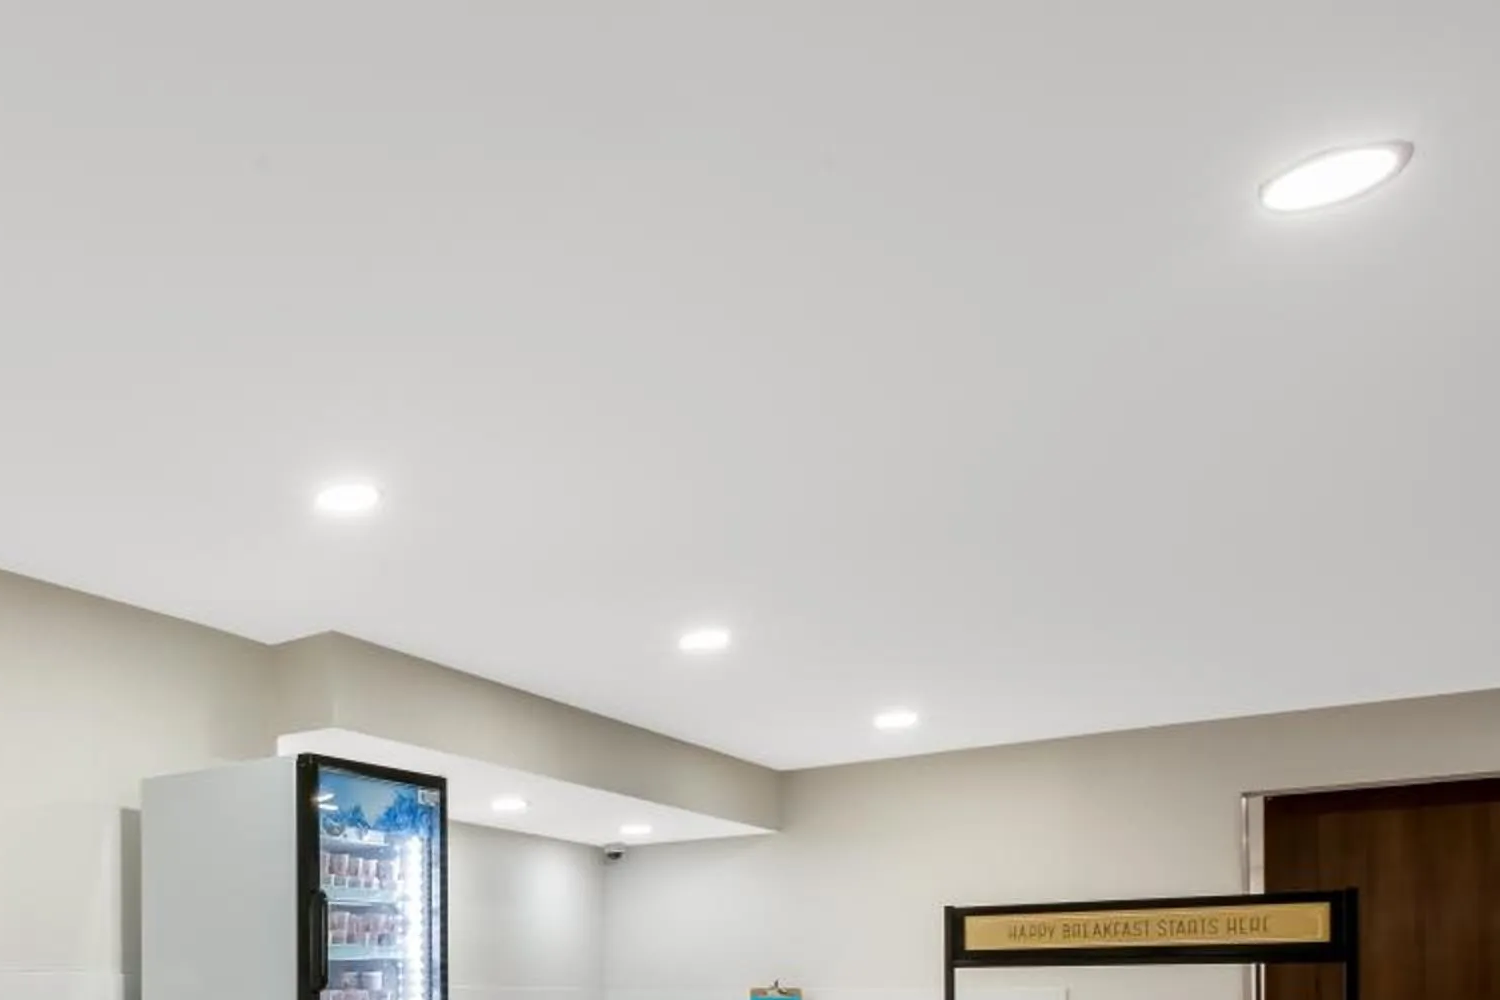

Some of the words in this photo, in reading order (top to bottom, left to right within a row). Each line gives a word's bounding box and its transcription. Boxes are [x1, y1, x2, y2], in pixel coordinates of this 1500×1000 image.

[1008, 924, 1055, 940] HAPPY
[1063, 920, 1149, 939] BREAKFAST
[1157, 918, 1219, 937] STARTS
[1227, 915, 1271, 935] HERE
